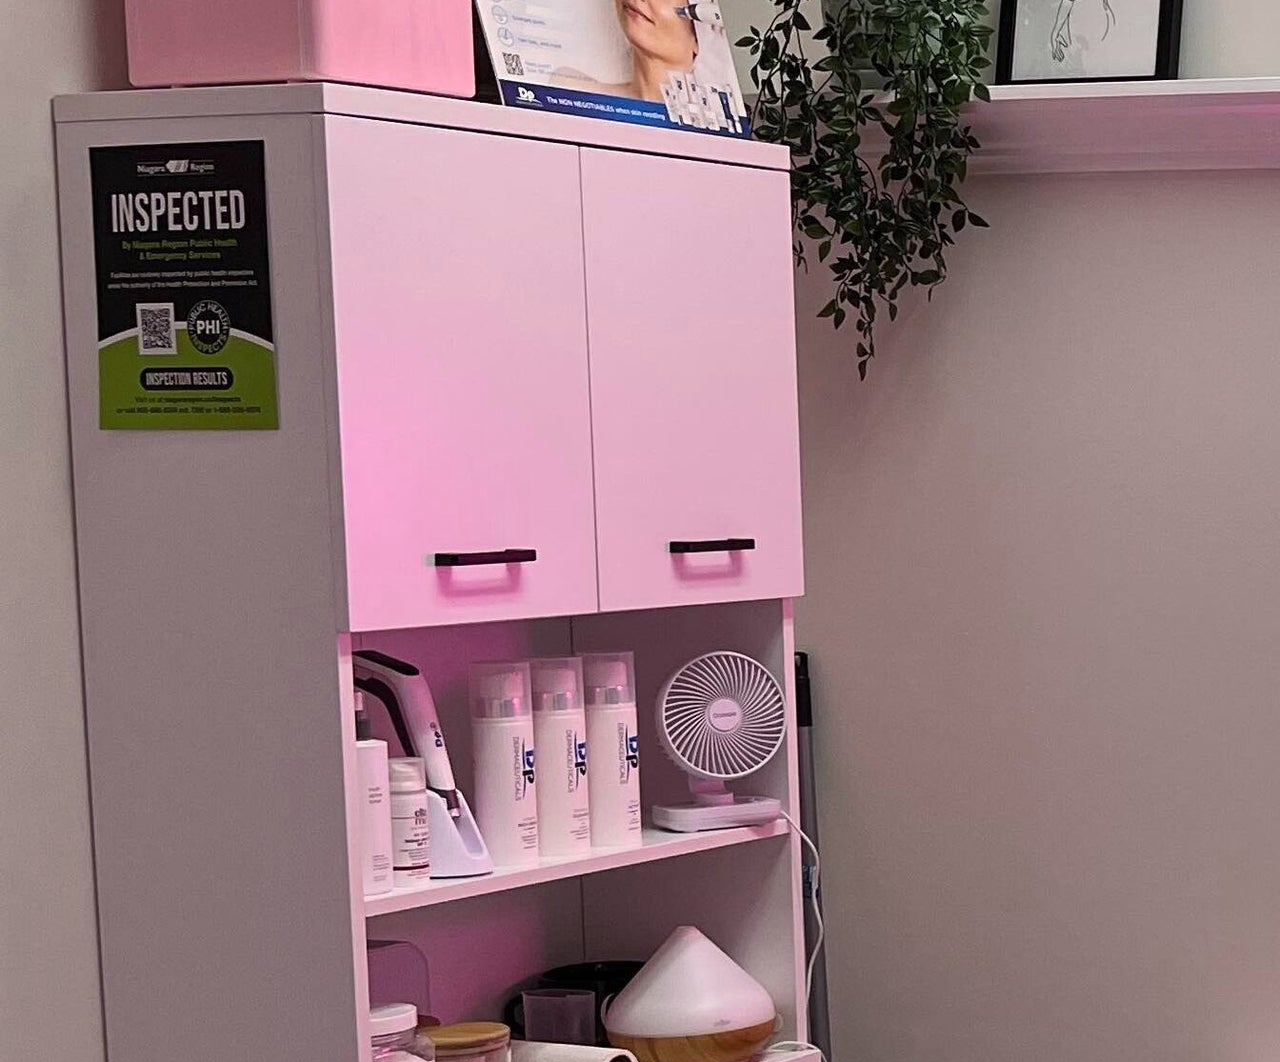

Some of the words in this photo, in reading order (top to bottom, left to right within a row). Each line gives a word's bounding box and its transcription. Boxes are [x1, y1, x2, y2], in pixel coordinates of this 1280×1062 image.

[111, 190, 246, 232] INSPECTED
[207, 301, 229, 330] HEALTH
[196, 320, 220, 335] PHI
[191, 333, 229, 353] INSPECTS
[145, 372, 192, 386] INSPECTION
[193, 371, 228, 385] RESULTS
